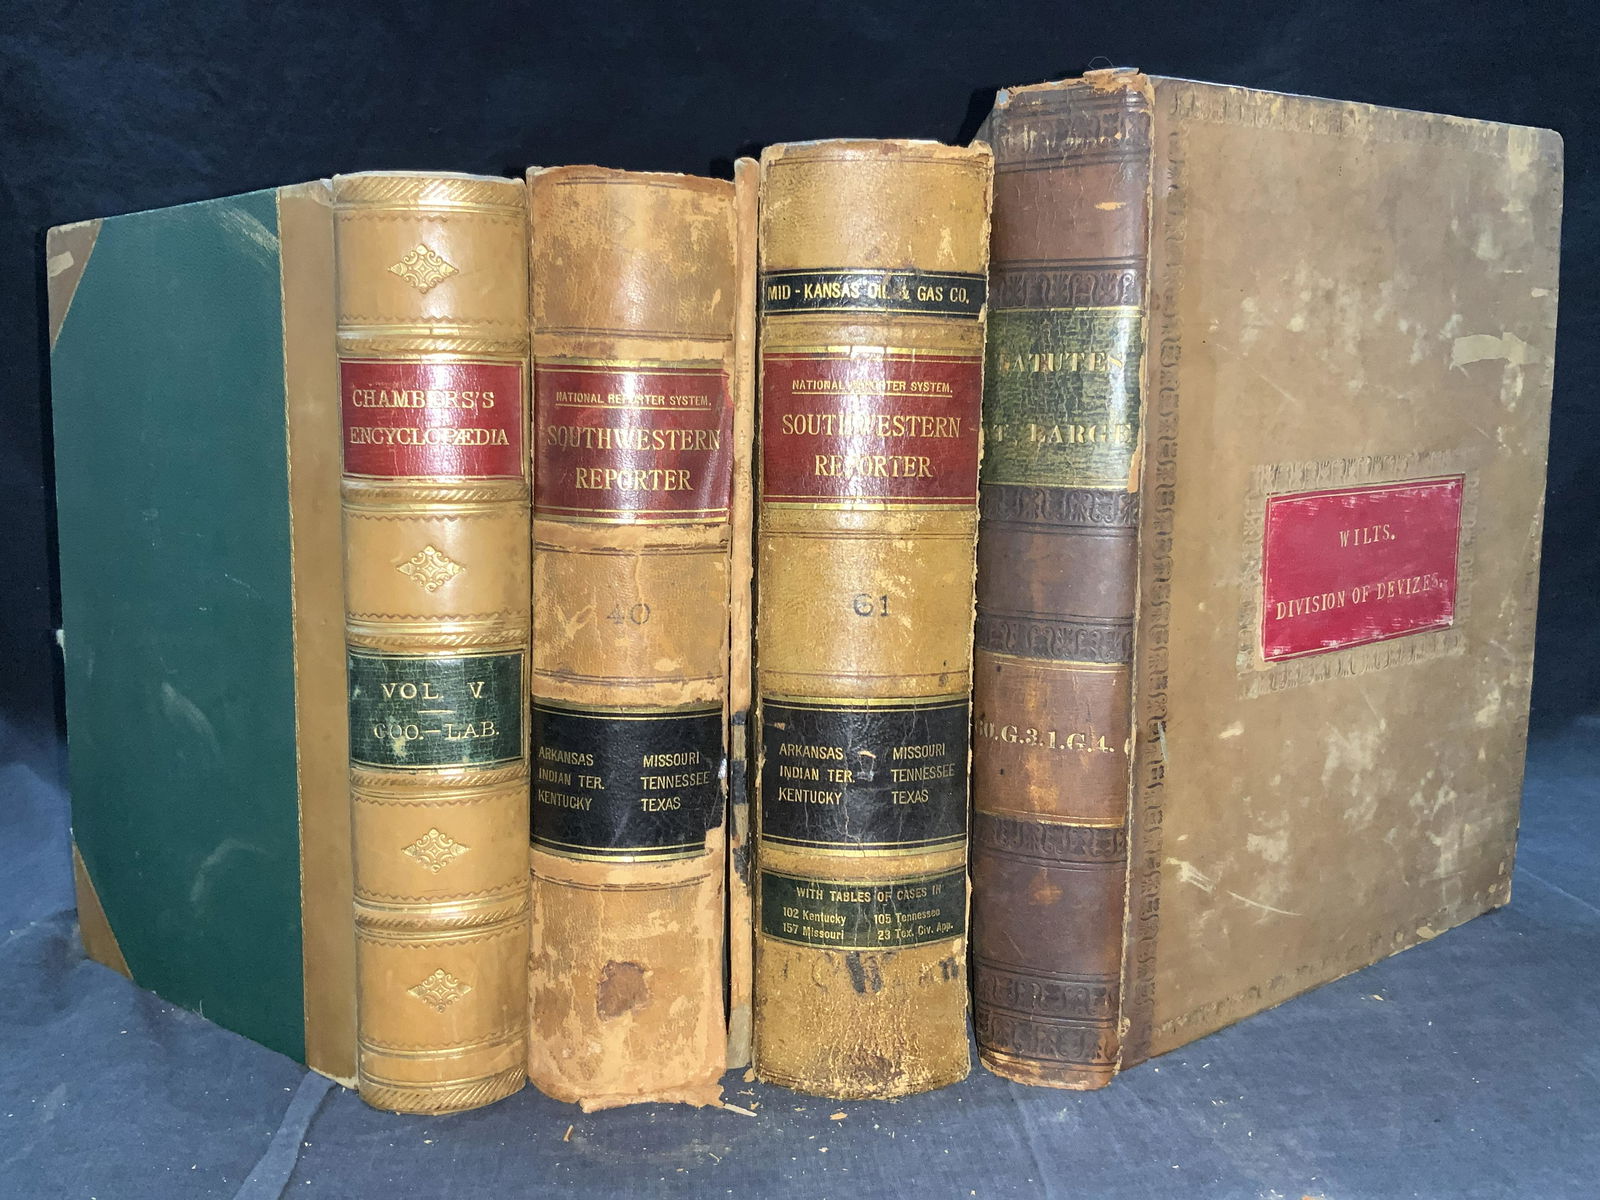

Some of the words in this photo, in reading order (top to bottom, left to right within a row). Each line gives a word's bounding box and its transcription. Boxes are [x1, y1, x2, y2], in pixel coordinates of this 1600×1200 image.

[917, 286, 943, 301] GAS
[792, 380, 844, 390] NATIONAL
[911, 381, 953, 393] SYSTEM.
[352, 389, 495, 410] CHAMBERS'S
[556, 392, 604, 404] NATIONAL
[608, 393, 665, 405] REPORTER
[669, 394, 712, 406] SYSTEM.
[547, 425, 721, 450] SOUTHWESTERN
[815, 455, 933, 478] REPORTER
[576, 467, 694, 491] REPORTER
[1339, 524, 1396, 547] WILTS.
[854, 594, 889, 617] 61
[1276, 590, 1346, 620] DIVISION
[1352, 585, 1371, 604] OF
[606, 603, 651, 625] 40
[381, 682, 444, 700] VOL.
[538, 746, 594, 767] ARKANSAS
[643, 751, 700, 768] MISSOURI
[779, 743, 844, 760] ARKANSAS
[892, 743, 945, 761] MISSOURI
[539, 768, 571, 786] INDIAN
[580, 774, 605, 791] TER.
[640, 771, 711, 791] TENNESSEE
[780, 765, 819, 782] INDIAN
[827, 768, 855, 784] TER.
[891, 763, 955, 783] TENNESSEE
[538, 791, 593, 811] KENTUCKY
[640, 796, 681, 812] TEXAS
[779, 788, 842, 805] KENTUCKY
[891, 790, 929, 804] TEXAS
[796, 887, 823, 900] WITH
[830, 890, 871, 903] TABLES
[878, 891, 892, 902] OF
[897, 887, 927, 901] CASES
[932, 884, 942, 896] IN
[783, 906, 799, 919] 102
[803, 909, 847, 926] Kentucky
[874, 913, 892, 925] 105
[895, 909, 941, 923] Tennessee
[783, 922, 799, 934] 157
[803, 925, 844, 940] Missouri
[878, 930, 891, 941] 23
[936, 921, 954, 934] App.
